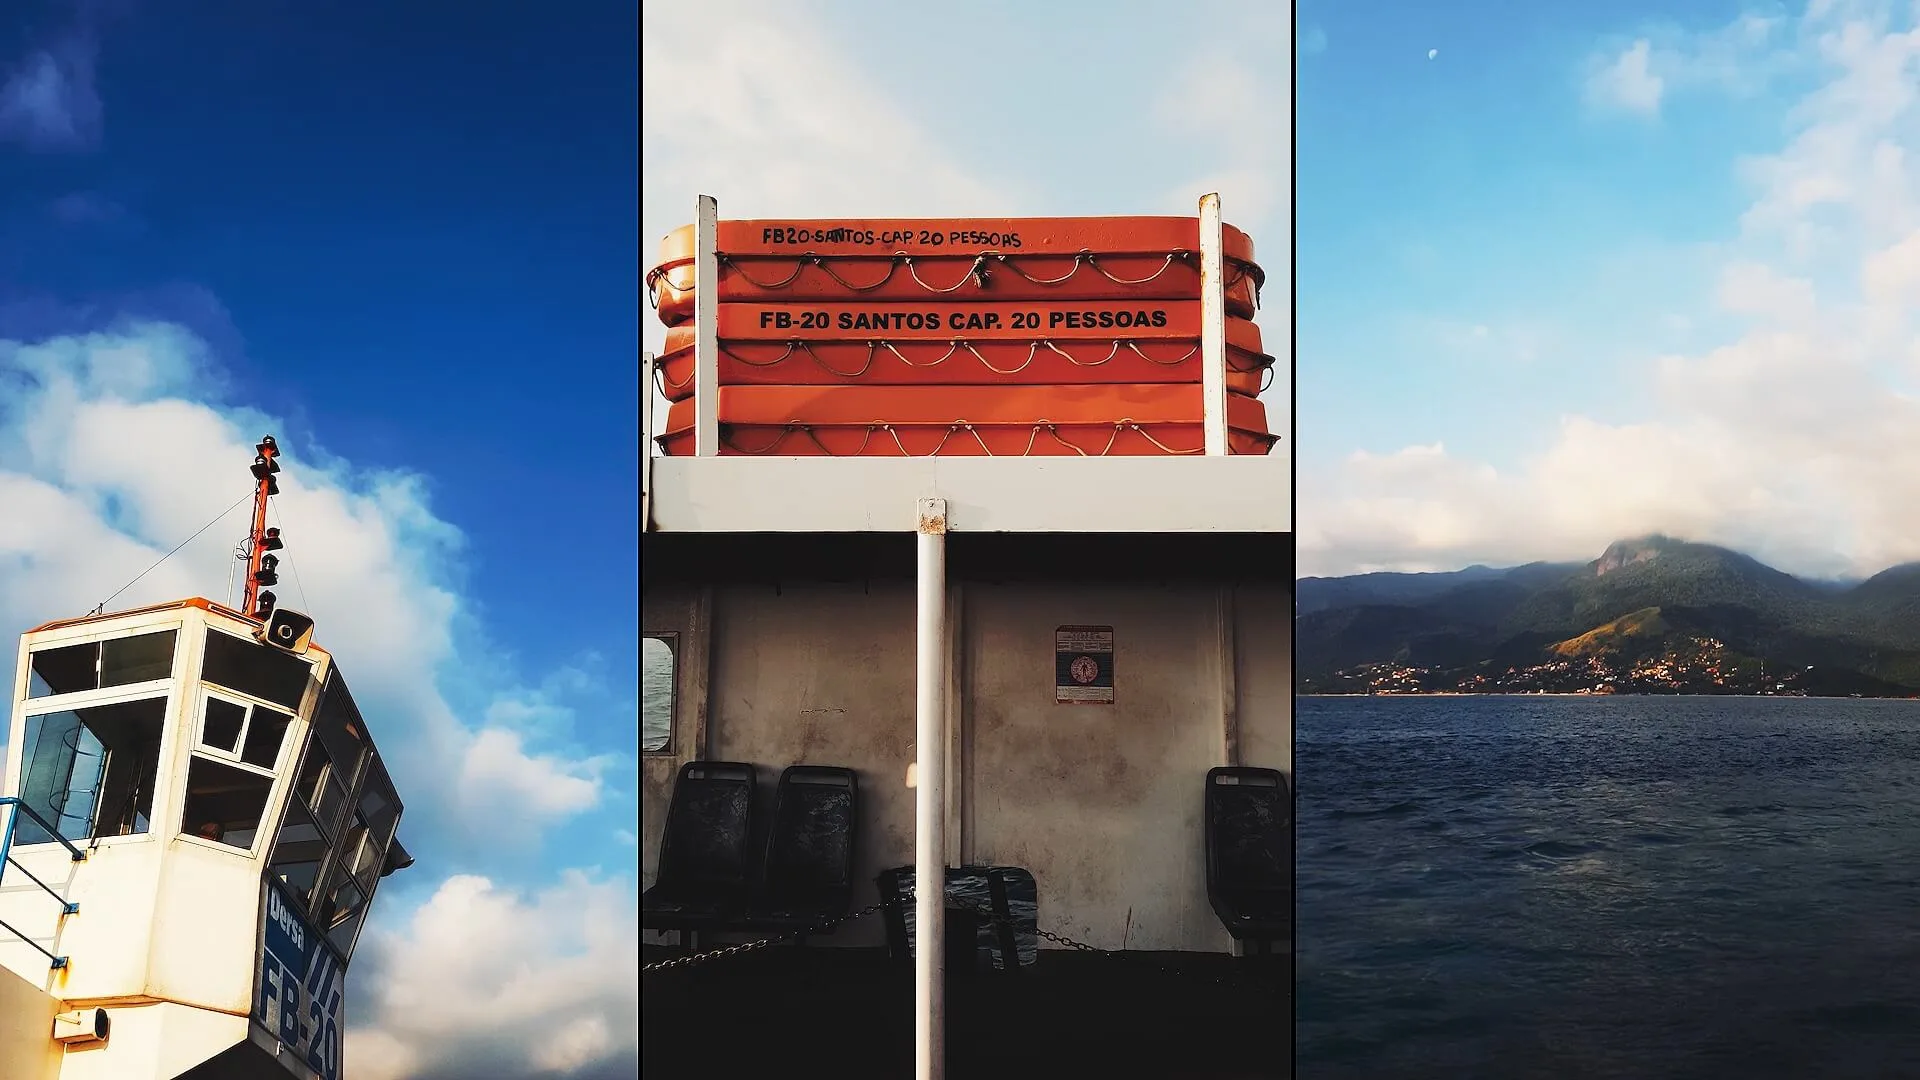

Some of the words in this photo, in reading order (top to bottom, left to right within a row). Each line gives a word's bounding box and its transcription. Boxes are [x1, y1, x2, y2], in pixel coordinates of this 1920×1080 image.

[919, 231, 944, 246] 20
[950, 231, 1022, 247] PESSOAS
[760, 312, 830, 329] FB-20
[838, 312, 941, 330] SANTOS
[948, 313, 1001, 330] CAP.
[1011, 312, 1040, 329] 20
[1049, 311, 1167, 329] PESSOAS
[269, 887, 305, 952] Dersa
[260, 956, 338, 1080] FB-20
